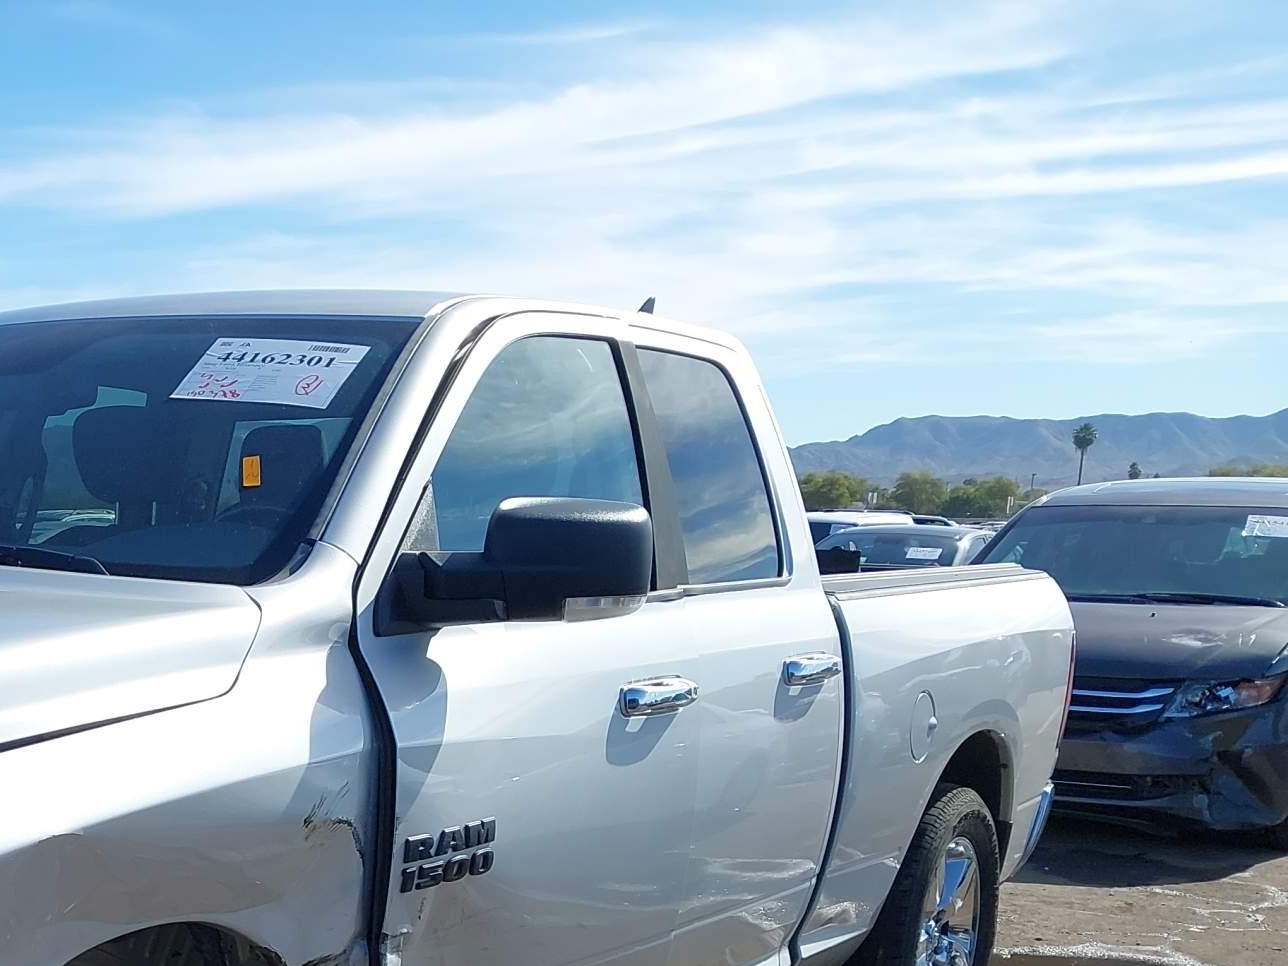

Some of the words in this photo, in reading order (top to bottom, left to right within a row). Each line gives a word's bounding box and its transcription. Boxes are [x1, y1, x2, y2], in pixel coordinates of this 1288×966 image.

[217, 351, 336, 368] 44162301
[403, 816, 496, 863] RAM
[400, 848, 495, 893] 1500
